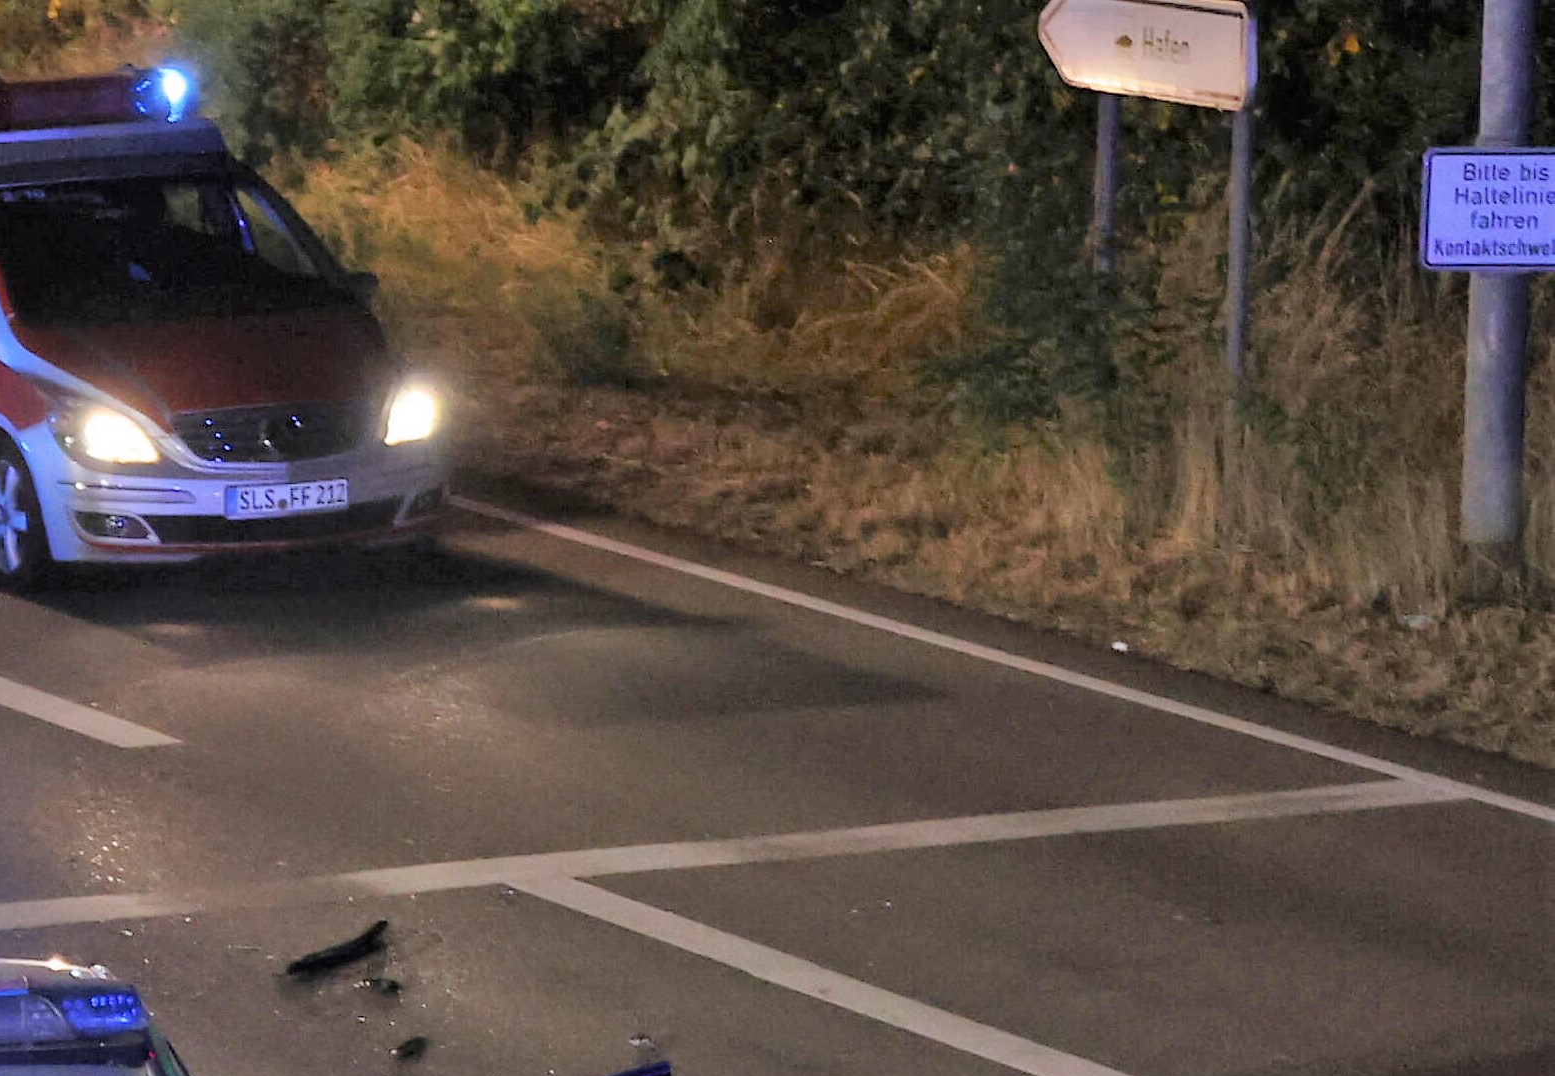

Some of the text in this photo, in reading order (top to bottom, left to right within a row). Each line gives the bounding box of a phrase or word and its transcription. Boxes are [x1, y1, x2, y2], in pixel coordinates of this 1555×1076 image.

[1463, 162, 1549, 181] Bitte bis
[1454, 186, 1555, 205] Haltelinie
[1470, 210, 1539, 229] fahren
[239, 488, 276, 510] SLS
[289, 485, 311, 508] FF
